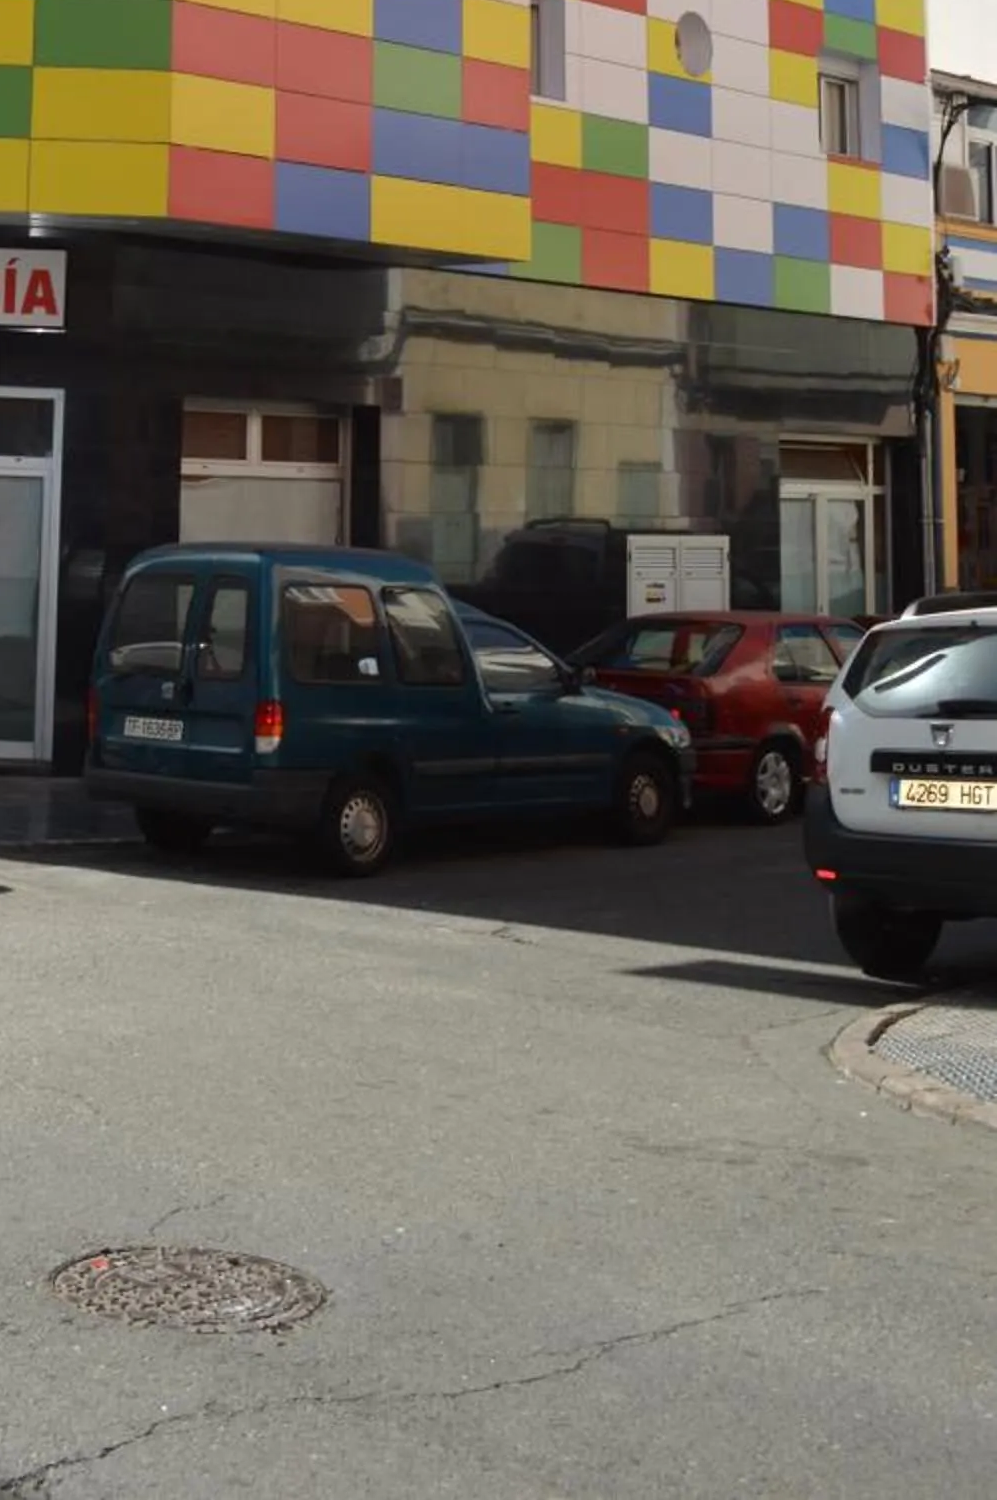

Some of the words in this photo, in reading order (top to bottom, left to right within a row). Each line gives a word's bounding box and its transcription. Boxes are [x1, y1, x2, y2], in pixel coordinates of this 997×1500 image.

[891, 762, 994, 776] DUSTER
[906, 782, 949, 804] 4269
[960, 785, 994, 806] HGT
